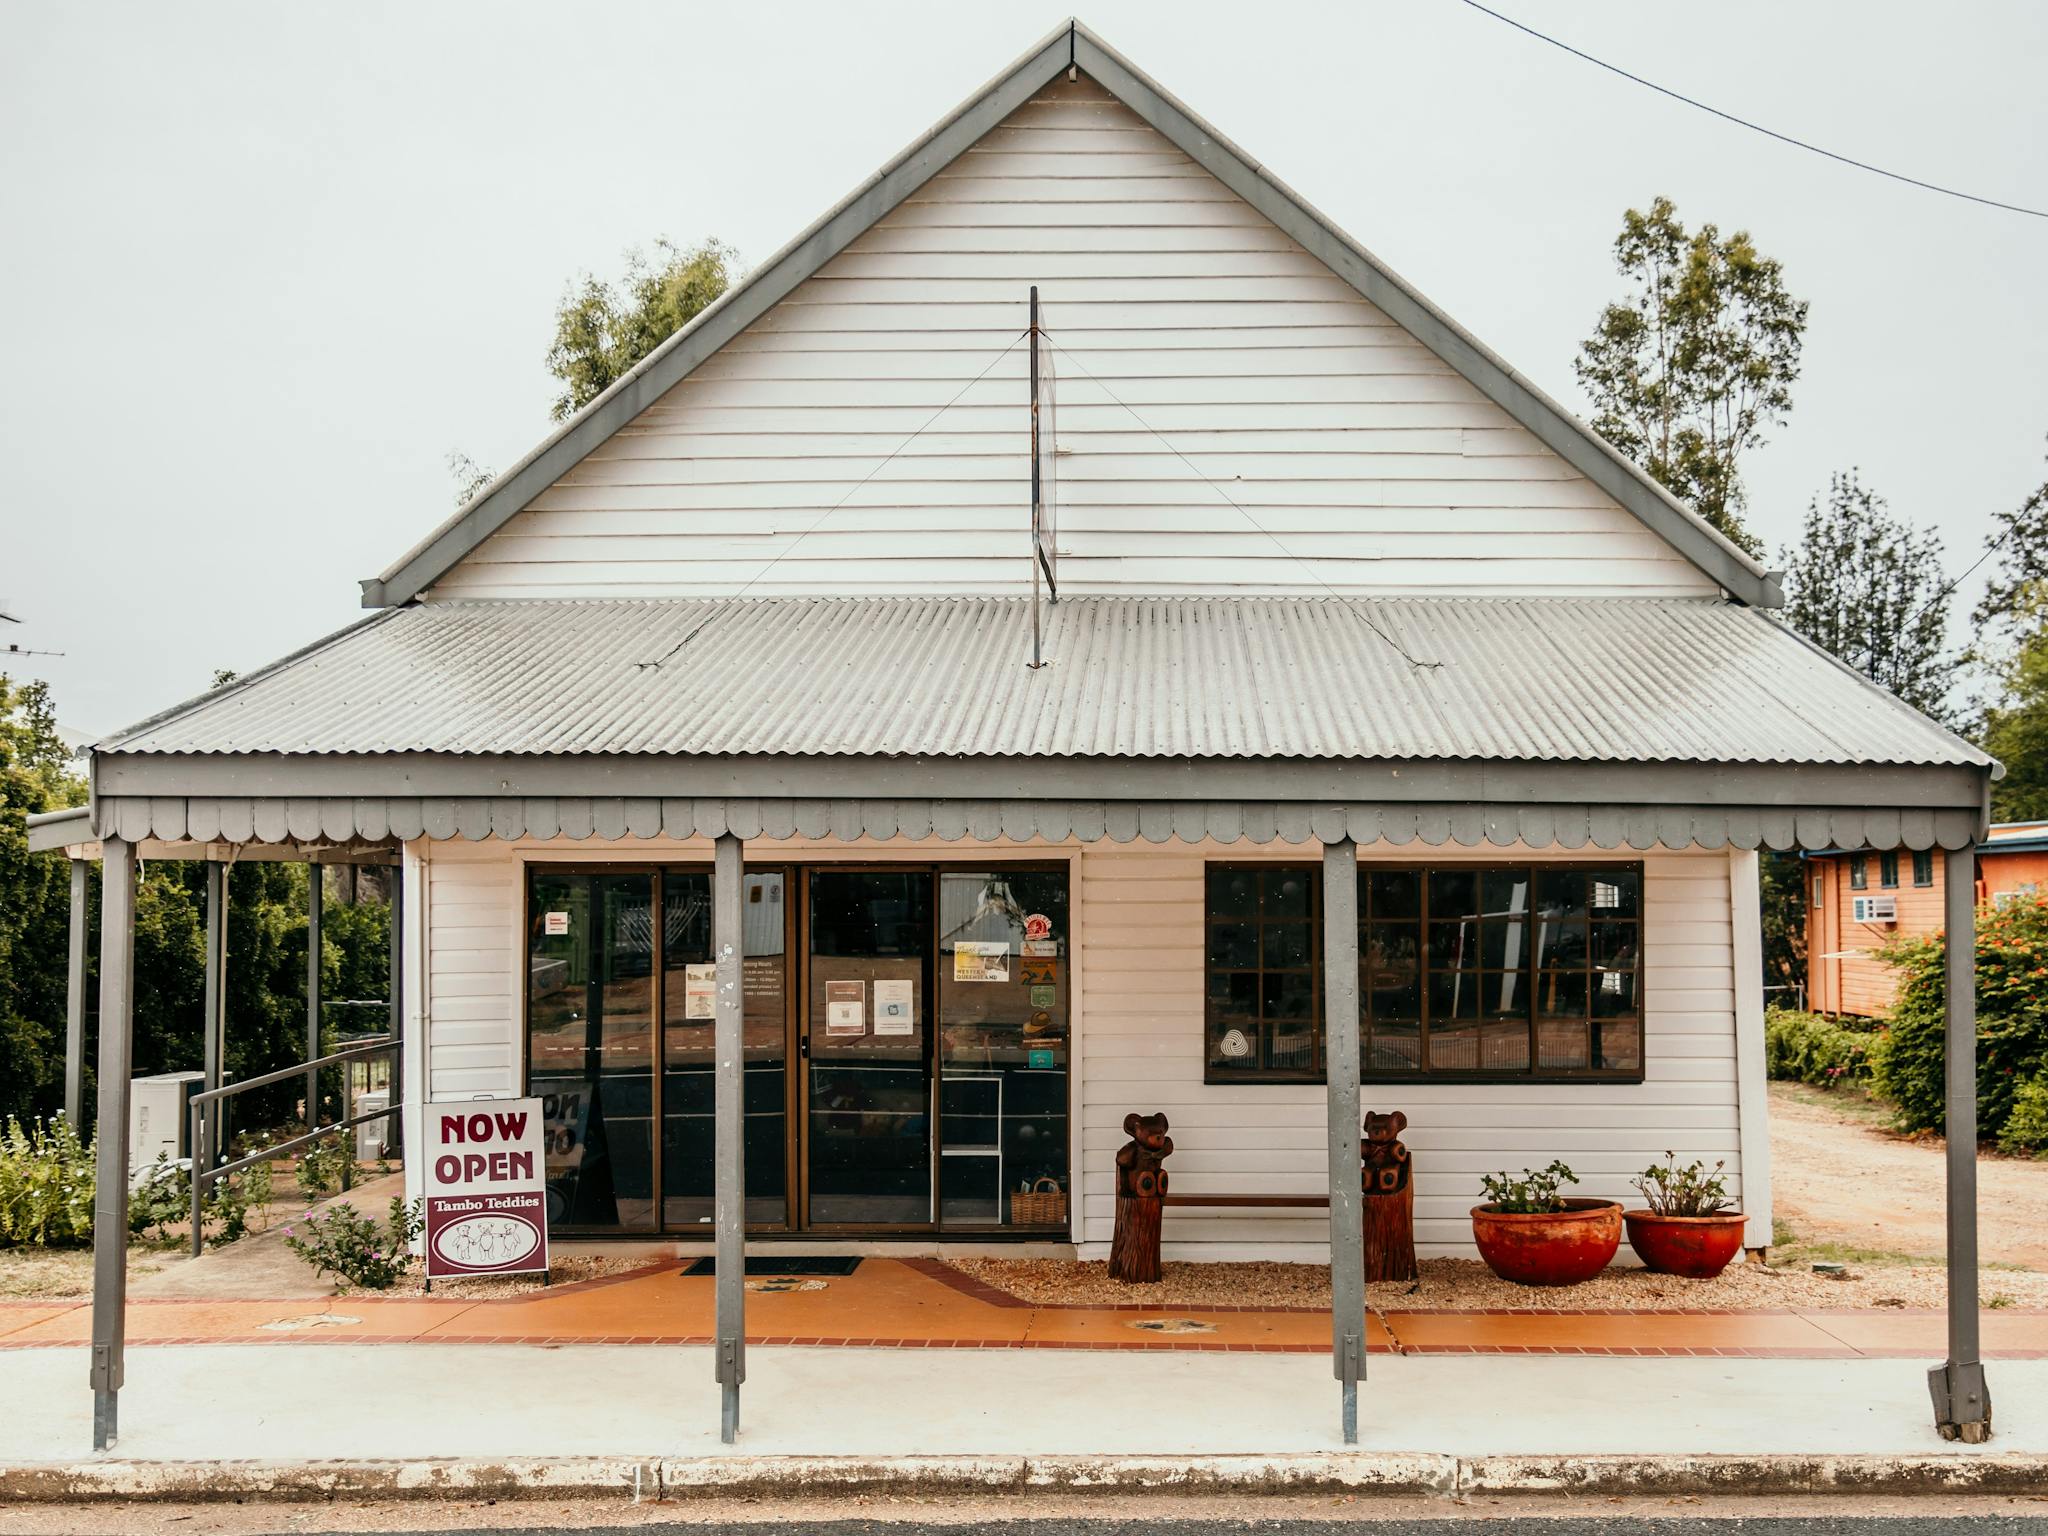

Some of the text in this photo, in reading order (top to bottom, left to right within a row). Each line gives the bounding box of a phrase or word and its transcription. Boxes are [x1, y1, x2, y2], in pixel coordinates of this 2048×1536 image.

[441, 1112, 527, 1144] NOW
[435, 1151, 533, 1184] OPEN
[434, 1196, 539, 1212] Tambo Teddies
